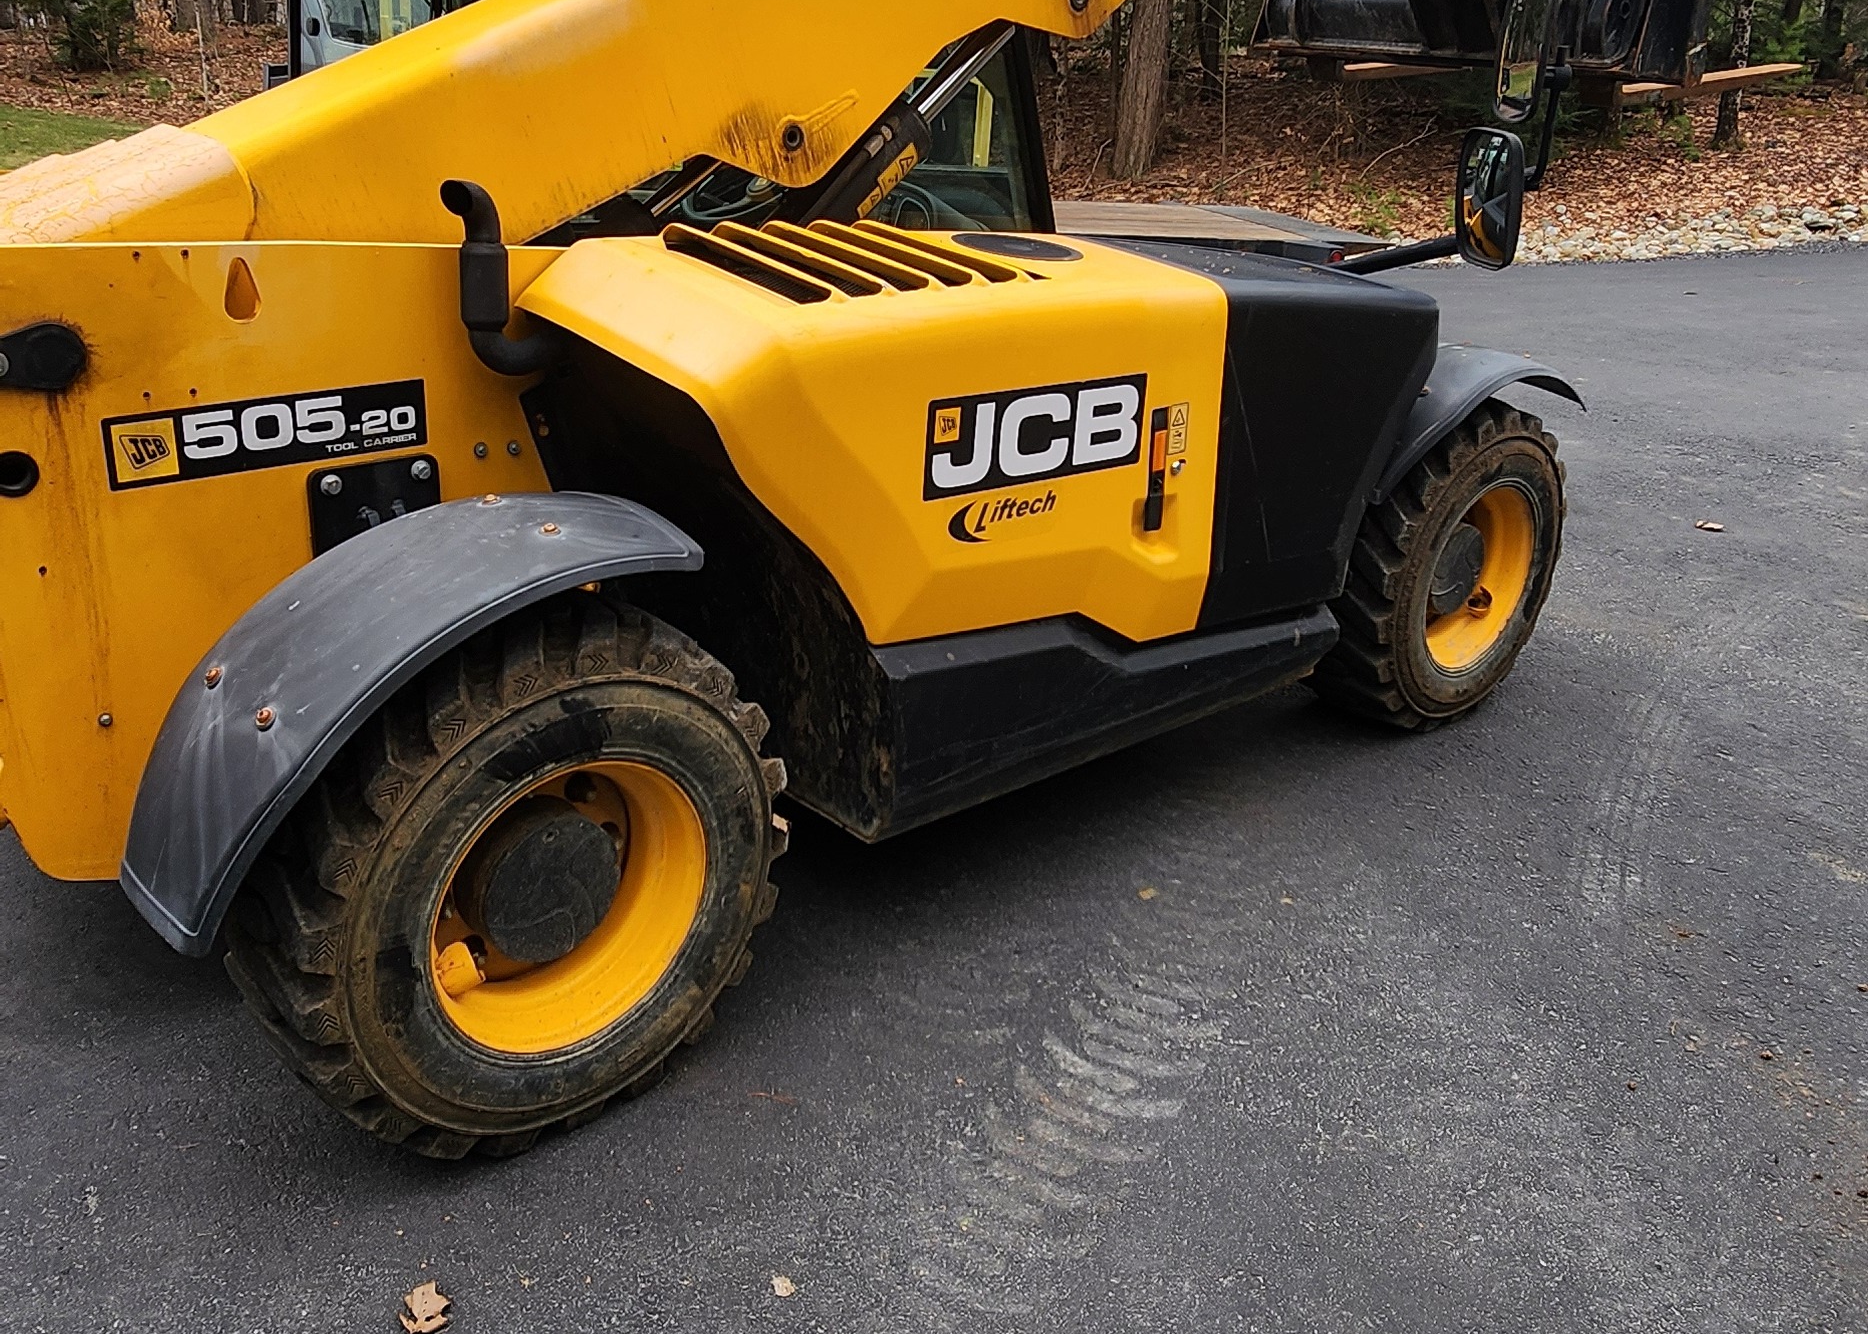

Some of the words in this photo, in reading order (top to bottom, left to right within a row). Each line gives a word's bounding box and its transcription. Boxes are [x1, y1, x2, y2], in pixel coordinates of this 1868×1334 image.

[931, 384, 1139, 488] JCB
[941, 417, 956, 434] JCB
[128, 438, 167, 464] JCB
[325, 442, 359, 453] TOOL
[363, 433, 417, 448] CARRIER
[973, 490, 1057, 533] Liftech
